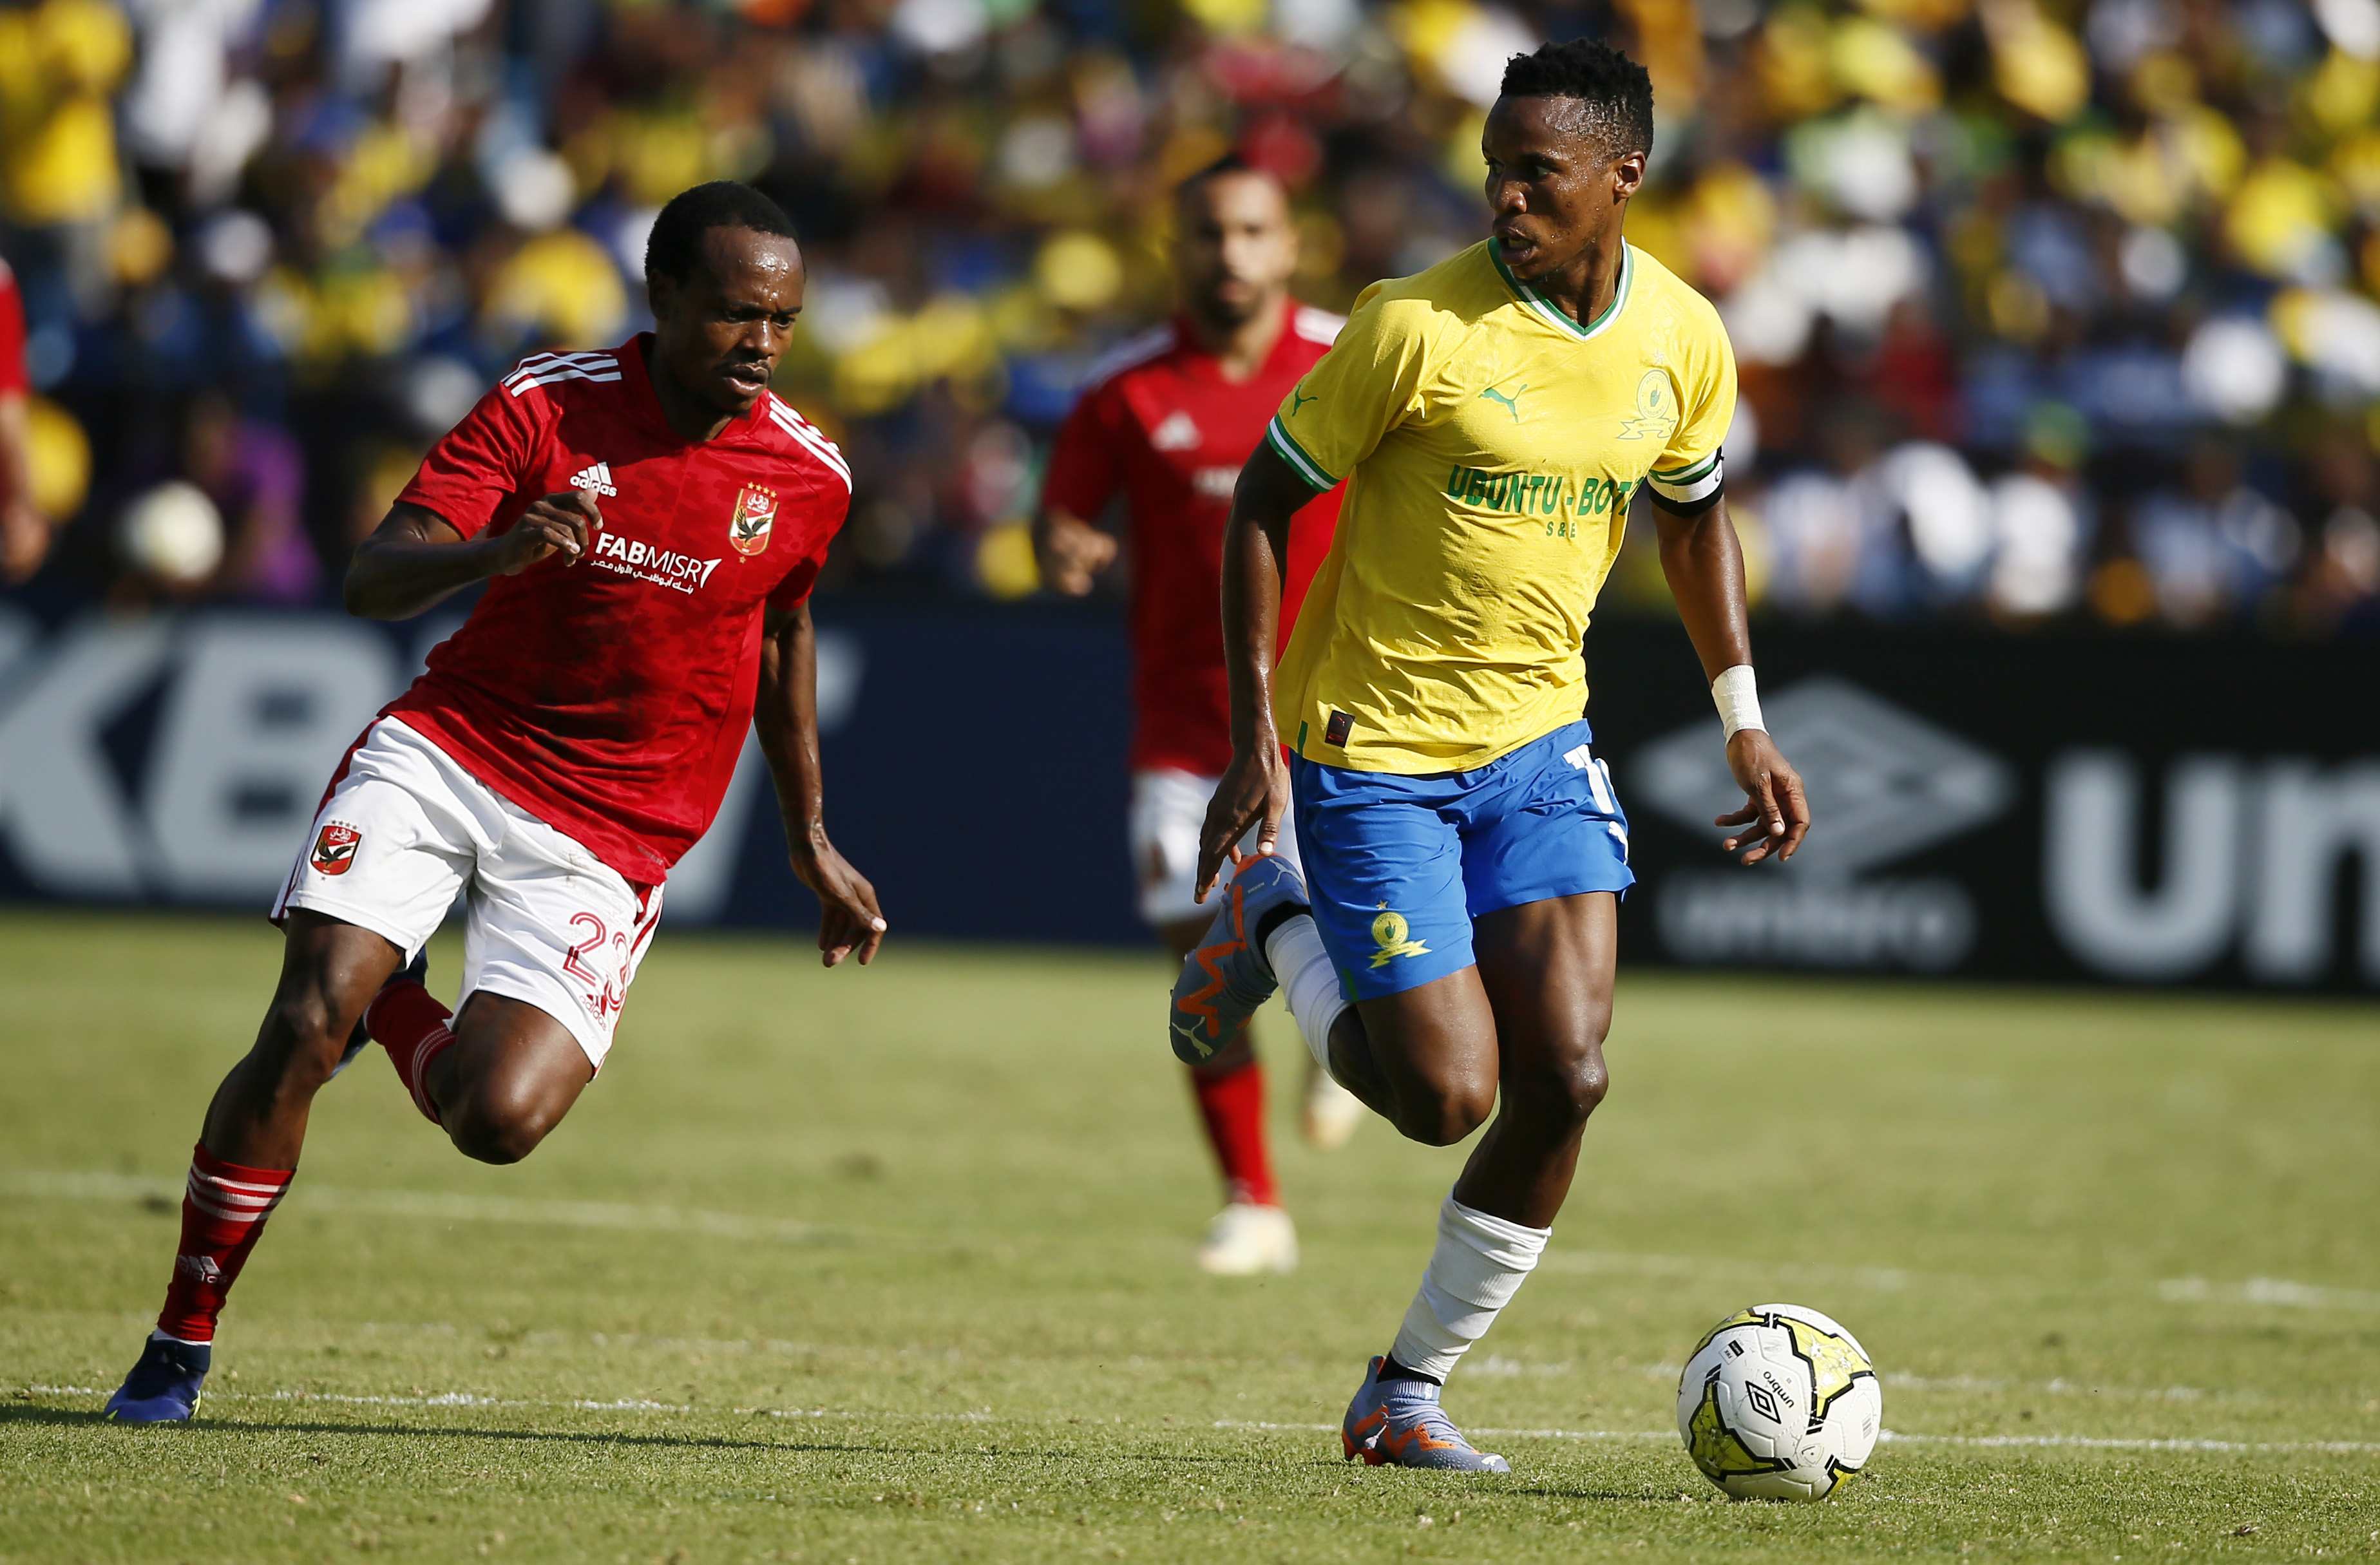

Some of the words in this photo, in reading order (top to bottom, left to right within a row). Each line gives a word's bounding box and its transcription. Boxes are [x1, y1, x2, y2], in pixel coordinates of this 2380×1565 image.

[569, 475, 618, 497] adidas
[1448, 464, 1563, 515] UBUNTU
[1763, 1371, 1795, 1408] umbro
